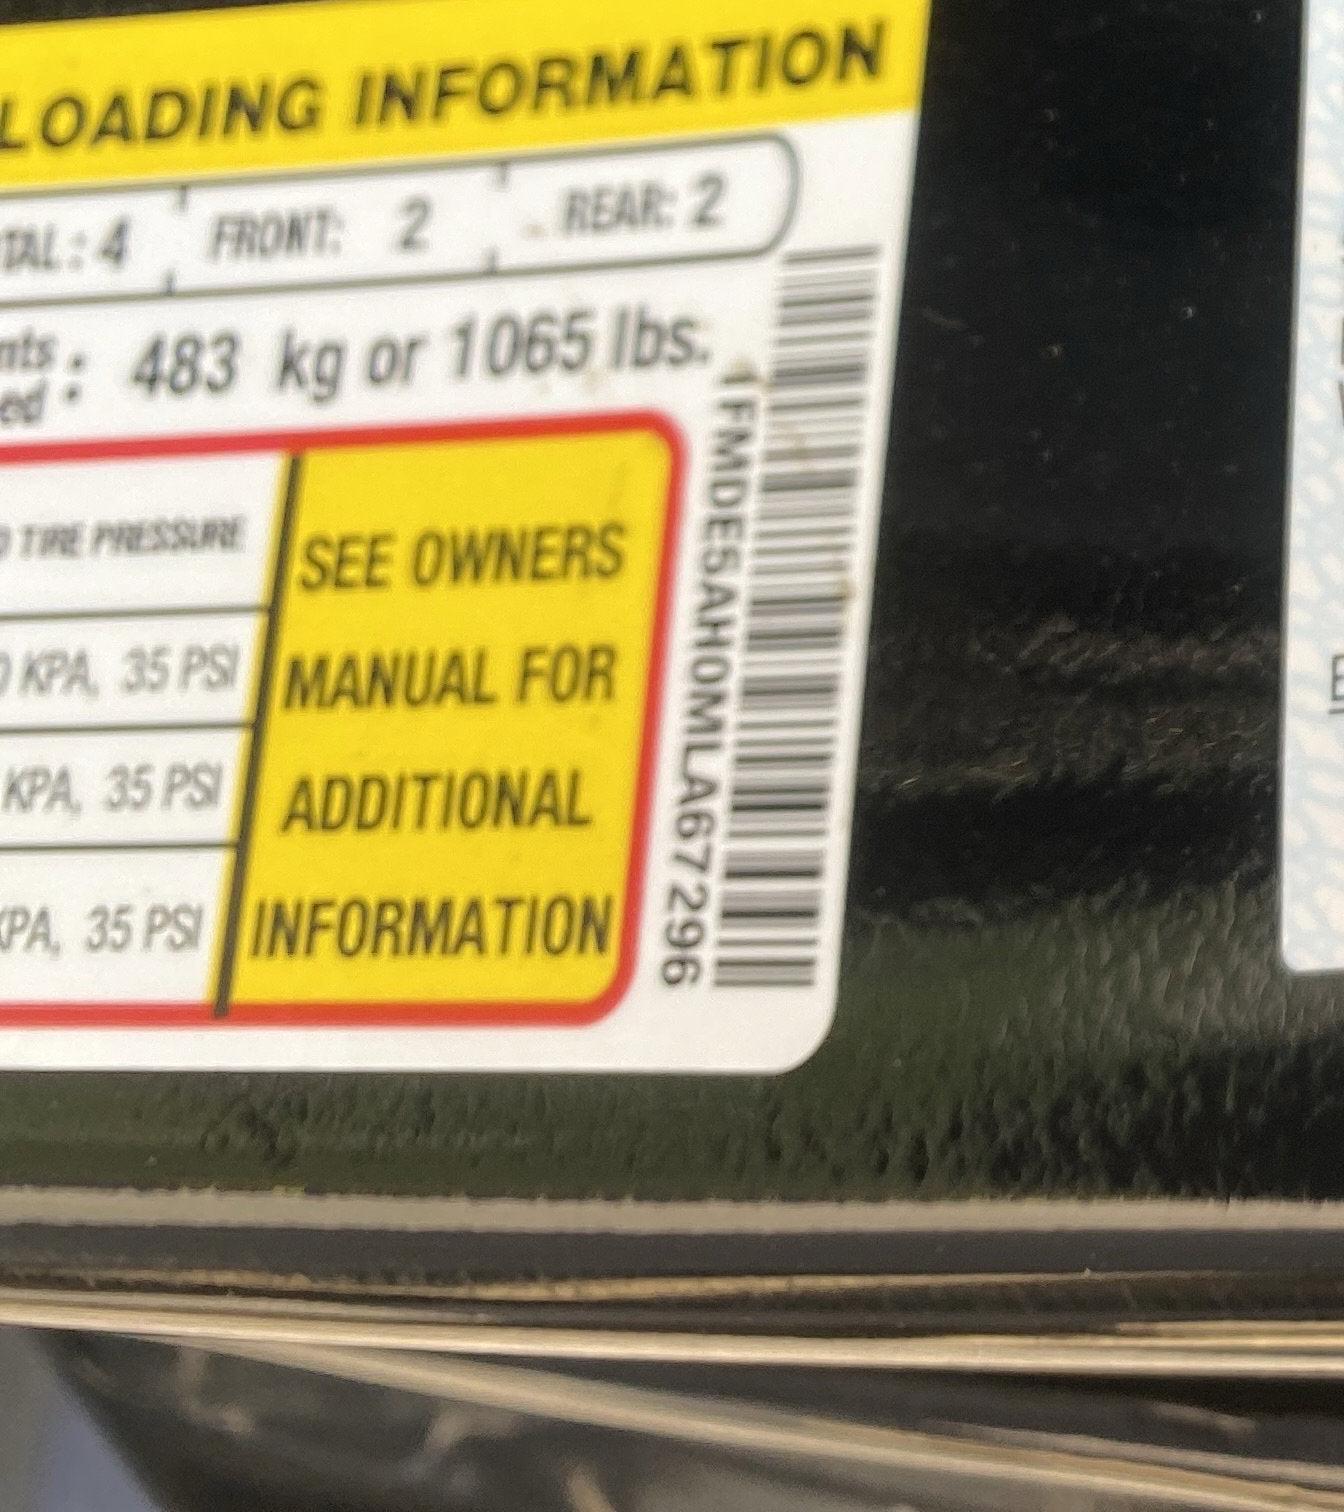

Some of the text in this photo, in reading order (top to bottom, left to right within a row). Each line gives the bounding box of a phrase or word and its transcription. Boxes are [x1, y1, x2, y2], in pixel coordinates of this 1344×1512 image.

[0, 22, 884, 150] LOADING INFORMATION
[211, 195, 432, 264] FRONT: 2
[562, 173, 726, 237] REAR: 2
[131, 330, 238, 396] 483
[279, 329, 345, 404] kg
[368, 334, 425, 386] or
[449, 307, 591, 377] 1065
[612, 304, 711, 371] lbs.
[300, 522, 626, 593] SEE OWNERS
[121, 644, 172, 695] 35
[177, 643, 241, 692] PSI
[284, 645, 617, 711] MANUAL FOR
[104, 762, 154, 813] 35
[160, 761, 224, 811] PSI
[280, 771, 592, 834] ADDITIONAL
[85, 903, 134, 953] 35
[142, 902, 204, 950] PSI
[249, 896, 612, 958] INFORMATION
